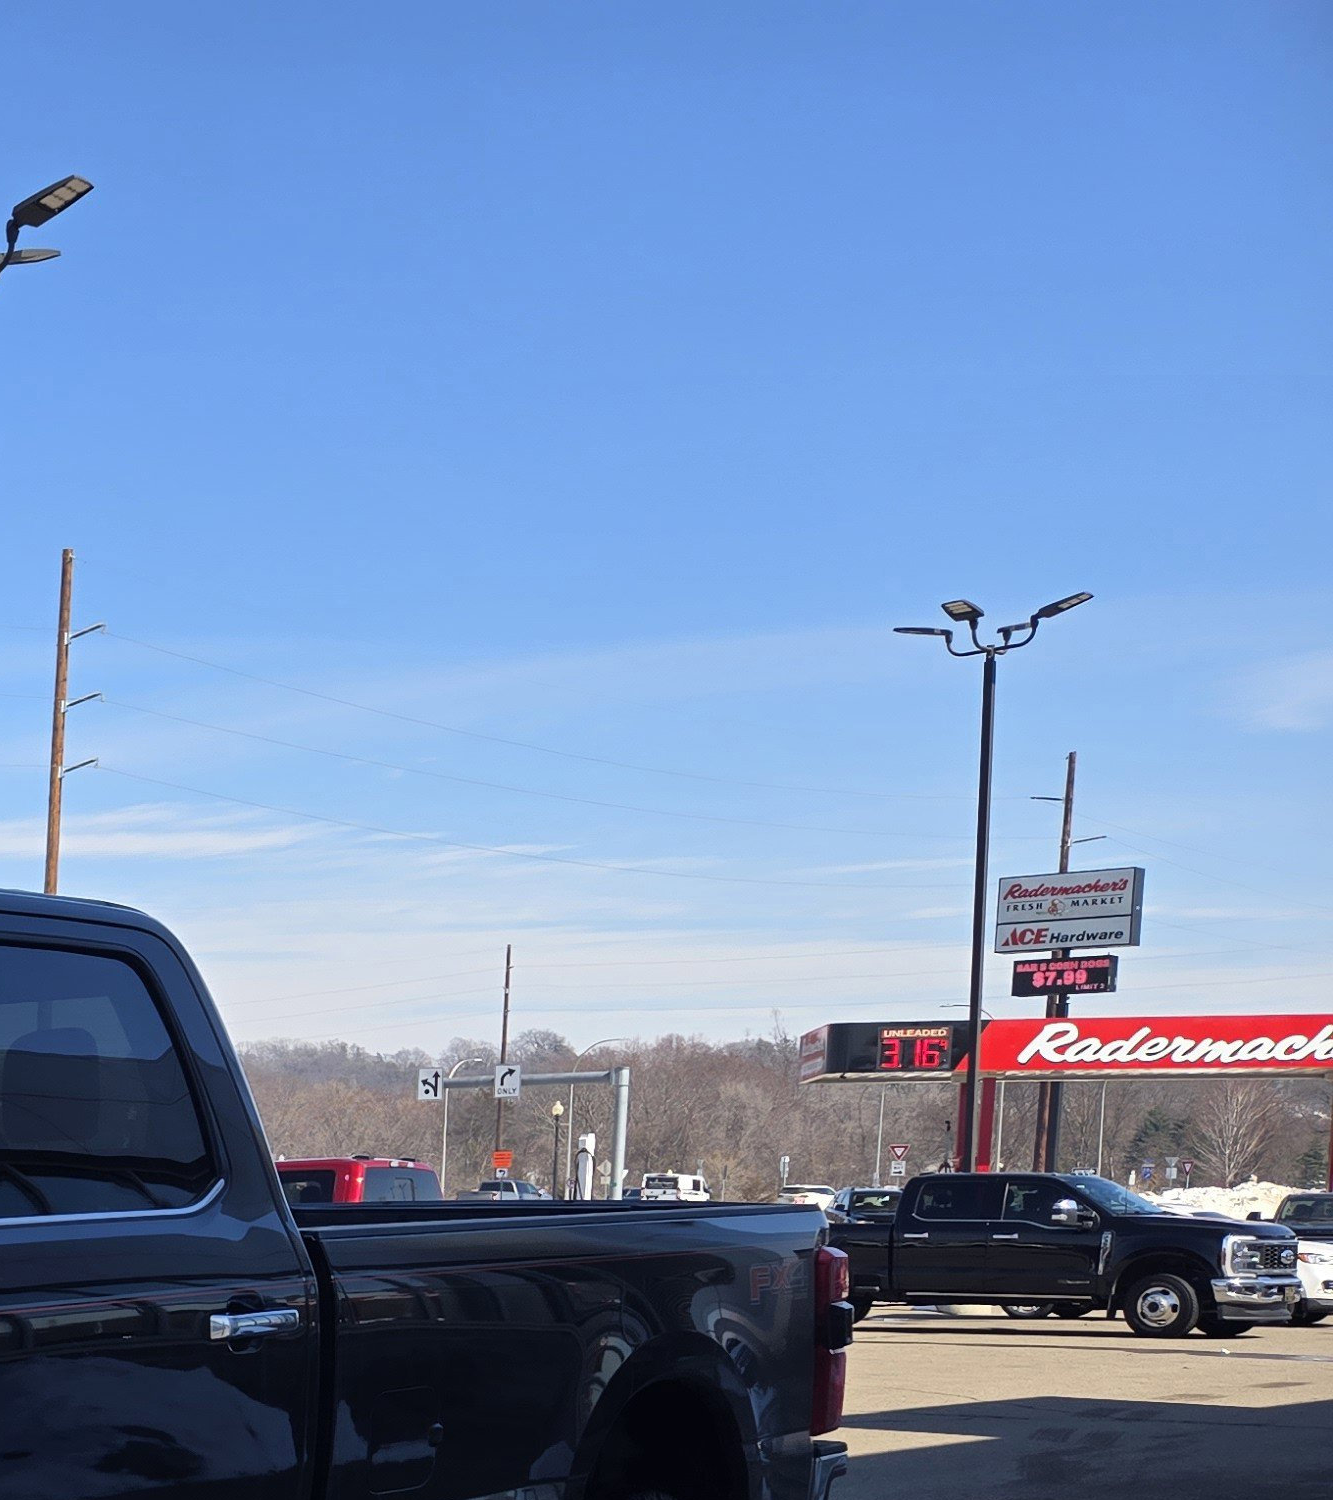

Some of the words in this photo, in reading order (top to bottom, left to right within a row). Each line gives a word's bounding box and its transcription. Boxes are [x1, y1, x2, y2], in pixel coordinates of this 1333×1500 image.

[1003, 878, 1129, 900] Radermacher's
[1006, 902, 1043, 912] FRESH
[1070, 896, 1124, 907] MARKET
[1001, 928, 1049, 946] ACE
[1049, 930, 1124, 944] Hardware
[1032, 969, 1088, 988] $7.99
[883, 1028, 947, 1038] UNLEADED
[497, 1087, 517, 1095] ONLY
